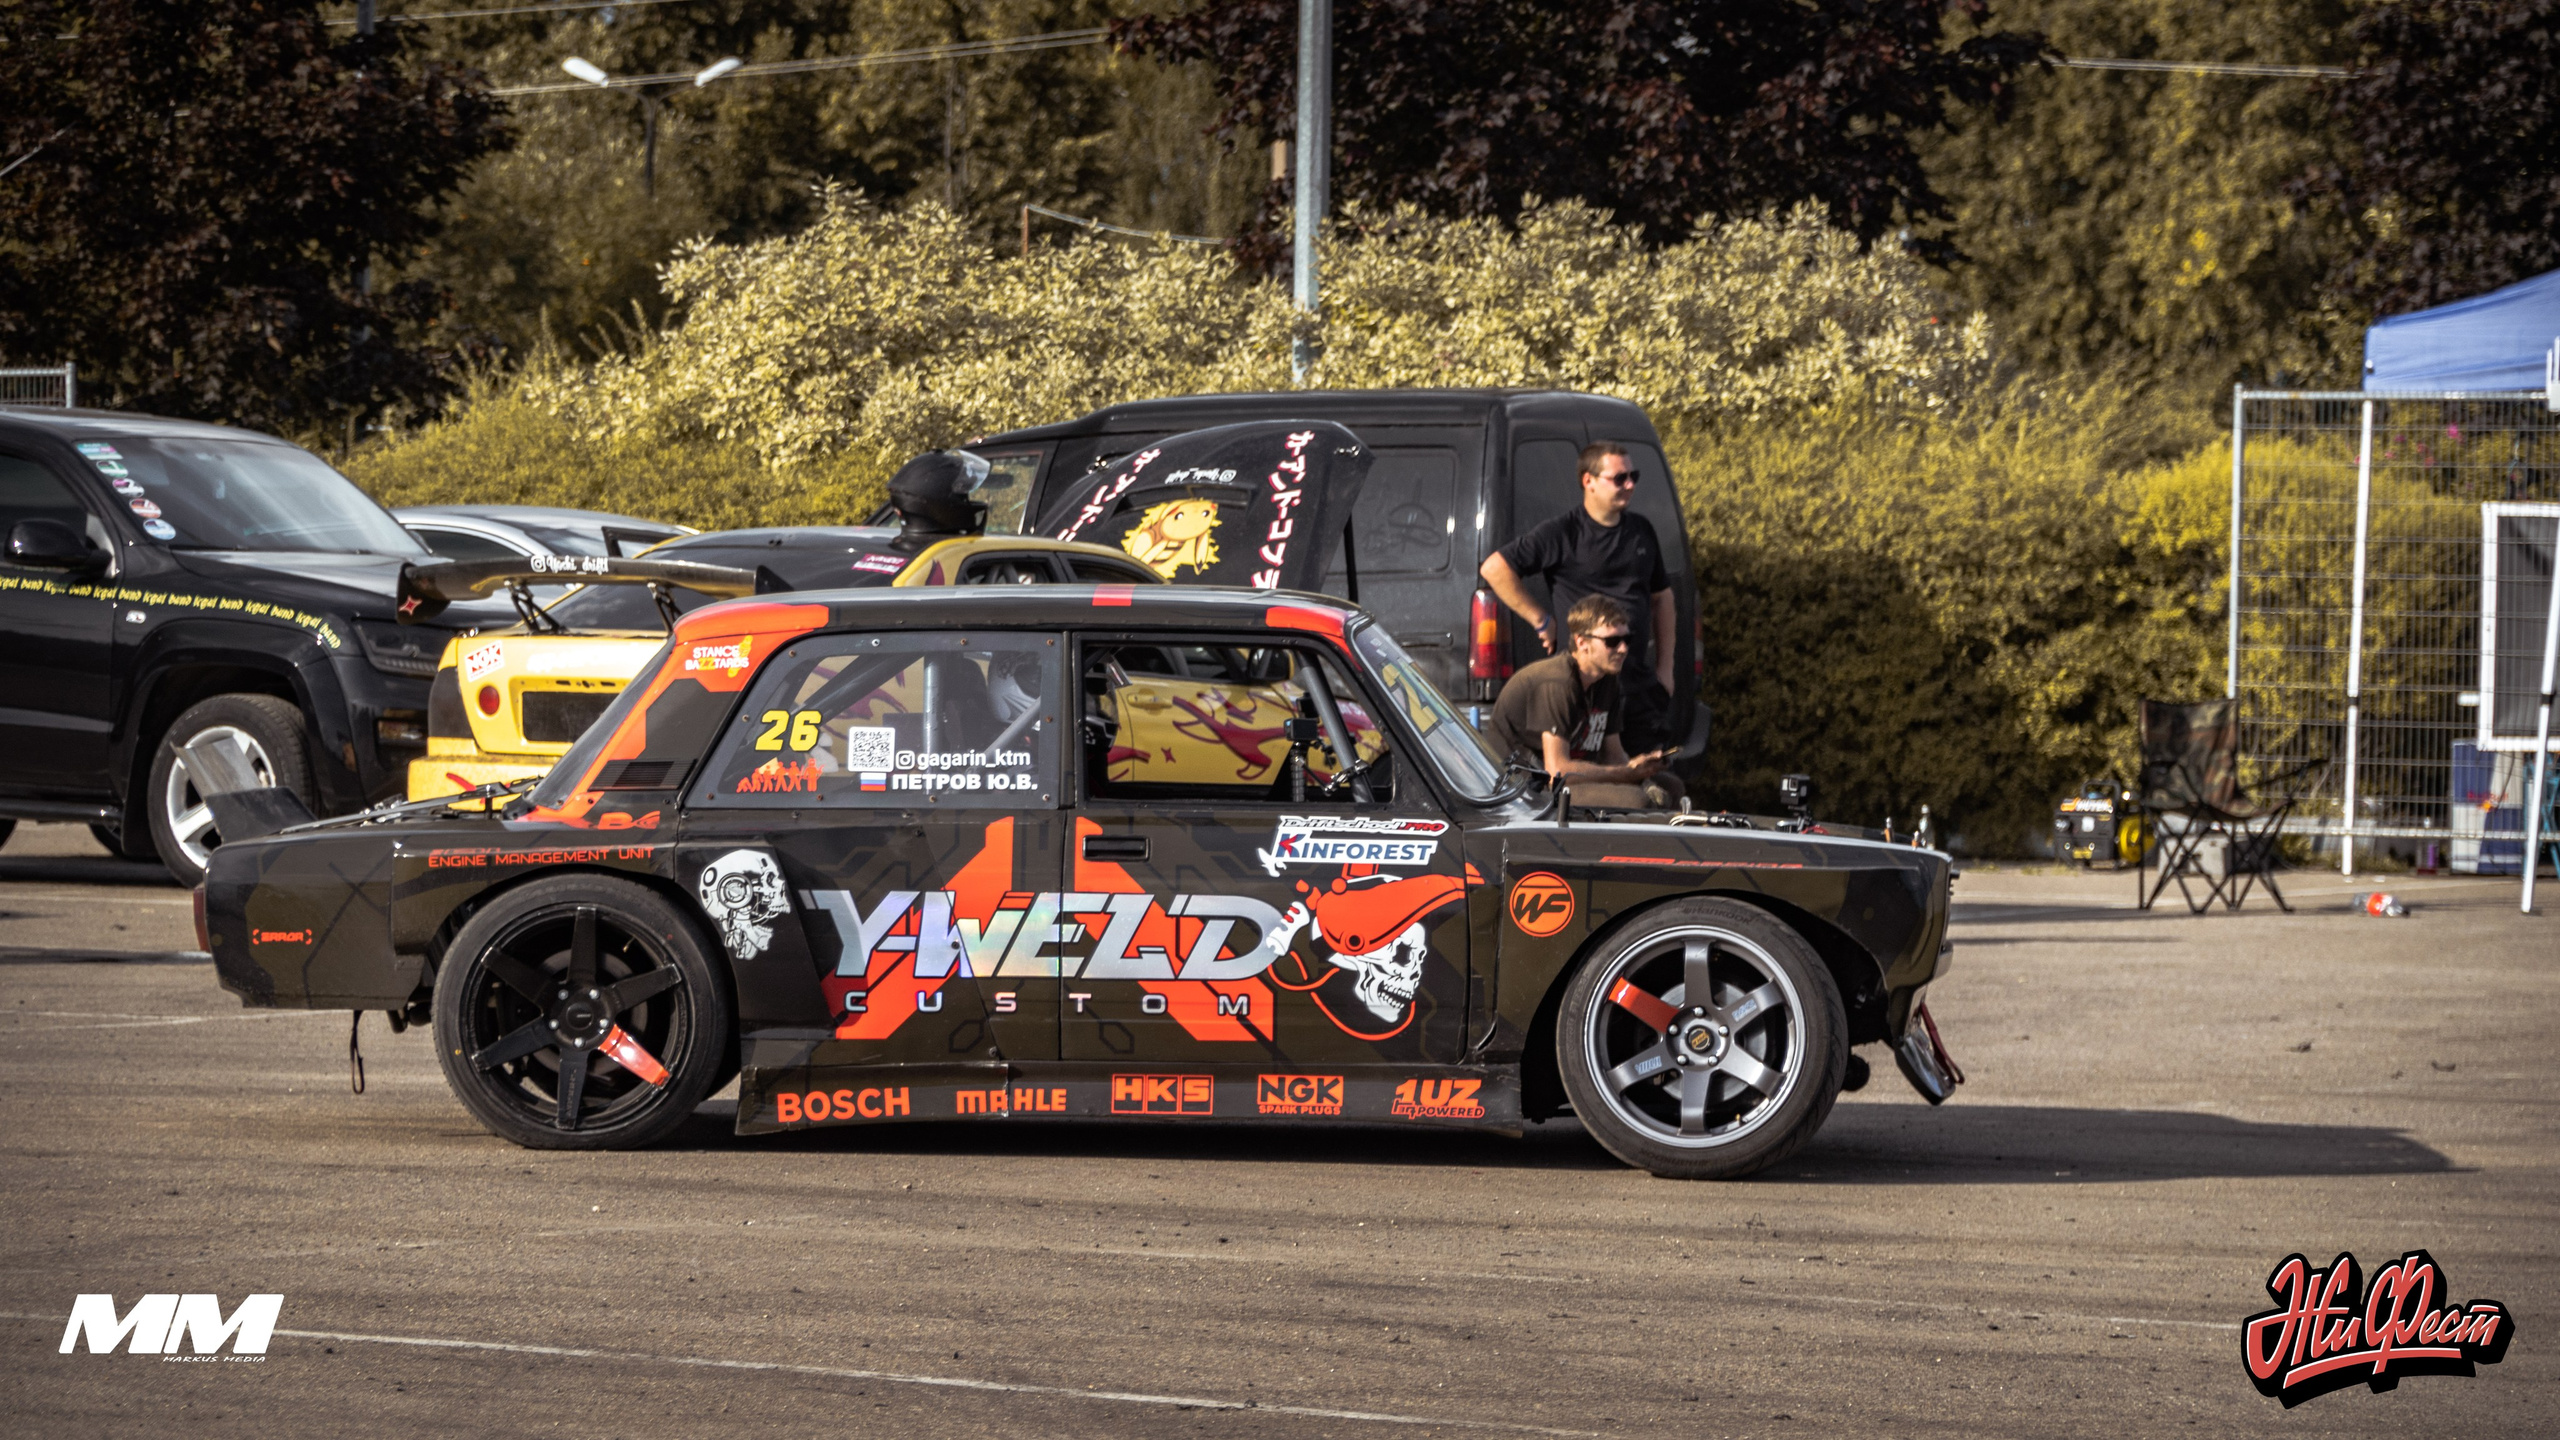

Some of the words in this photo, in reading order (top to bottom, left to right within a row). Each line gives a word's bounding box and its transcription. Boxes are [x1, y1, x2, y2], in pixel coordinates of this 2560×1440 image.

[755, 709, 822, 752] 26
[917, 749, 1031, 771] gagarin_ktm
[891, 773, 982, 791] ПЕТРОВ
[986, 773, 1038, 791] Ю.В.
[428, 853, 487, 868] ENGINE
[495, 849, 610, 866] MANAGEMENT
[618, 847, 655, 860] UNIT
[1275, 833, 1433, 861] KINFOREST
[956, 1087, 1068, 1115] MAHLE
[1113, 1076, 1212, 1104] HKS
[1259, 1076, 1341, 1104] NGK
[1395, 1079, 1482, 1107] 1UZ
[777, 1086, 911, 1124] BOSCH
[1258, 1104, 1299, 1115] SPARK
